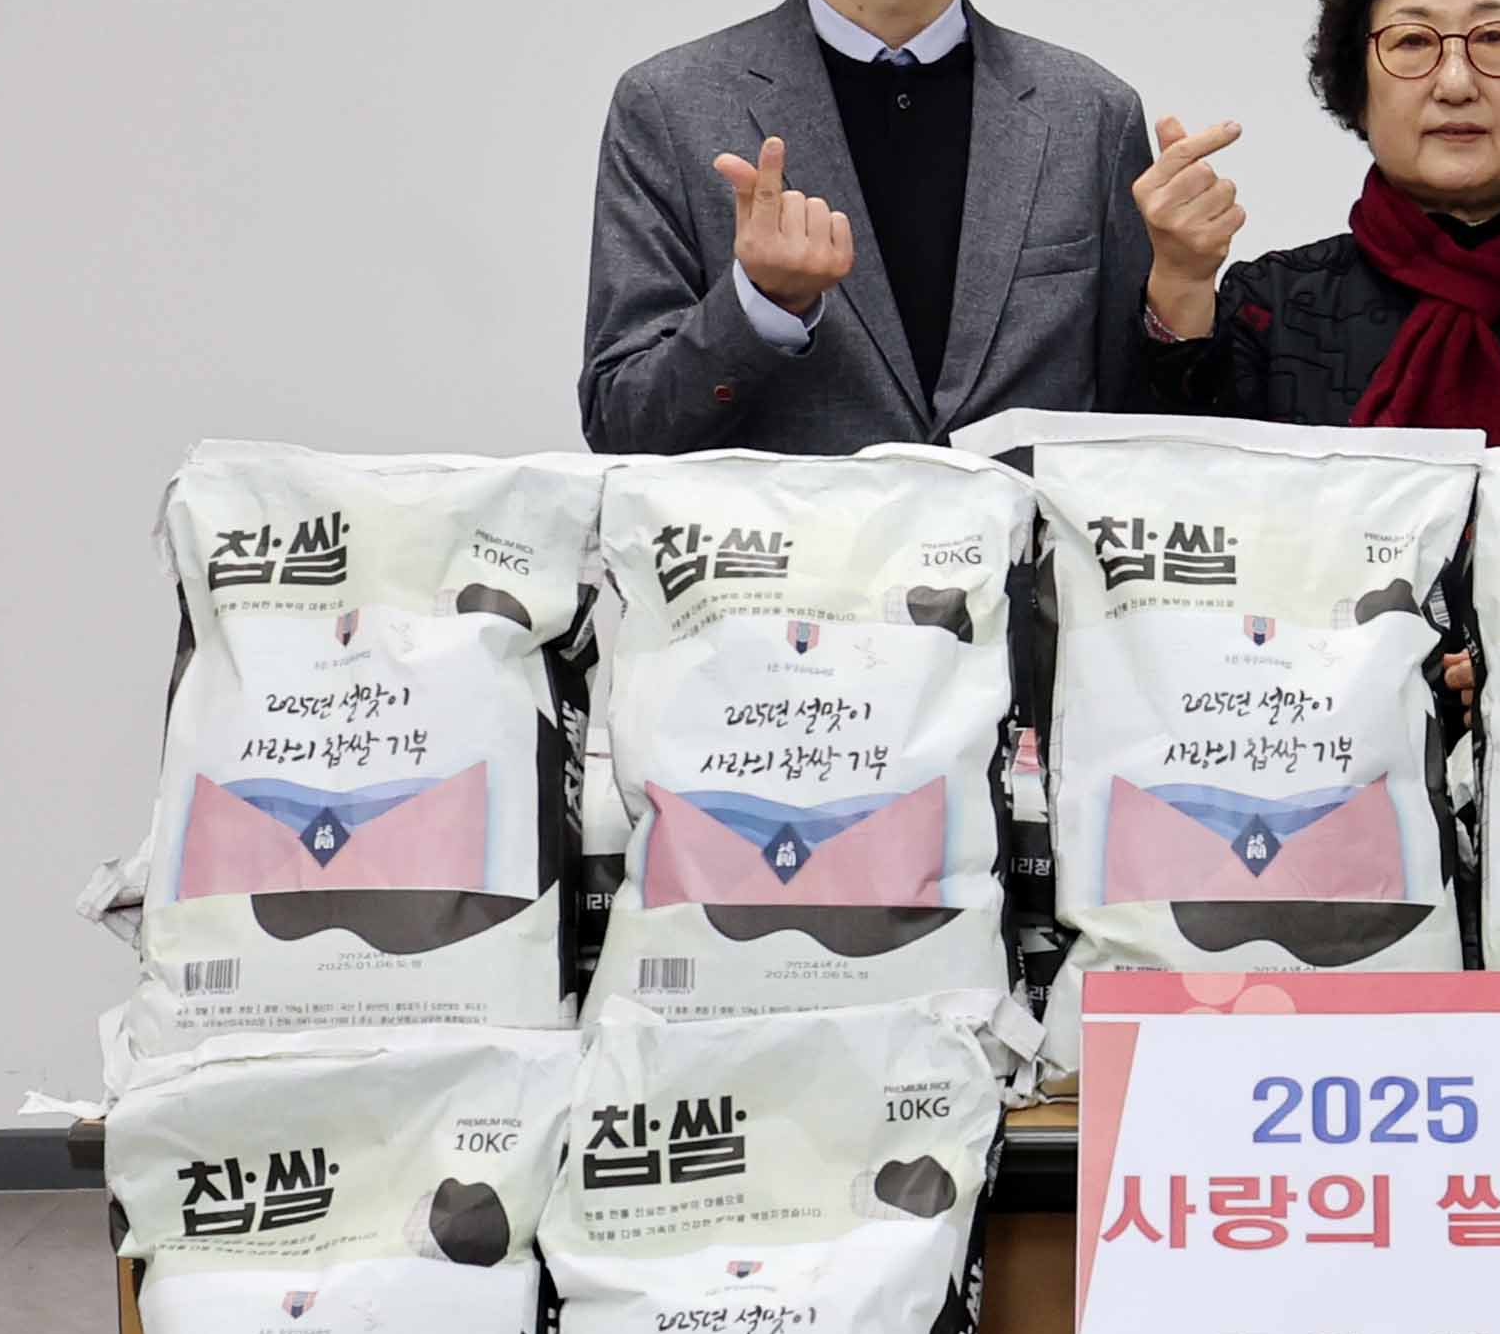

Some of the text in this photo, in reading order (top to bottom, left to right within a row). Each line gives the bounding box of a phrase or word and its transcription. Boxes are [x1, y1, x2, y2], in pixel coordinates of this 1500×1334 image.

[208, 511, 350, 591] 찹쌀
[470, 544, 531, 576] 10KG
[652, 523, 793, 605] 찹쌀
[922, 545, 982, 567] 10KG
[1088, 516, 1239, 591] 찹쌀
[267, 682, 410, 724] 2025년 설맞이
[724, 697, 872, 735] 2025년 설맞이
[1182, 686, 1333, 725] 2025년 설맞이
[241, 729, 428, 768] 사랑의 찹쌀 기부
[700, 745, 888, 782] 사랑의 찹쌀 기부
[1164, 737, 1354, 774] 사랑의 찹쌀 기부
[885, 1097, 951, 1122] 10KG
[1251, 1073, 1480, 1145] 2025
[453, 1131, 519, 1154] 10KG
[583, 1096, 747, 1190] 찹쌀
[178, 1147, 340, 1237] 찹쌀
[1101, 1171, 1391, 1251] 사랑의
[656, 1305, 727, 1332] 2025년
